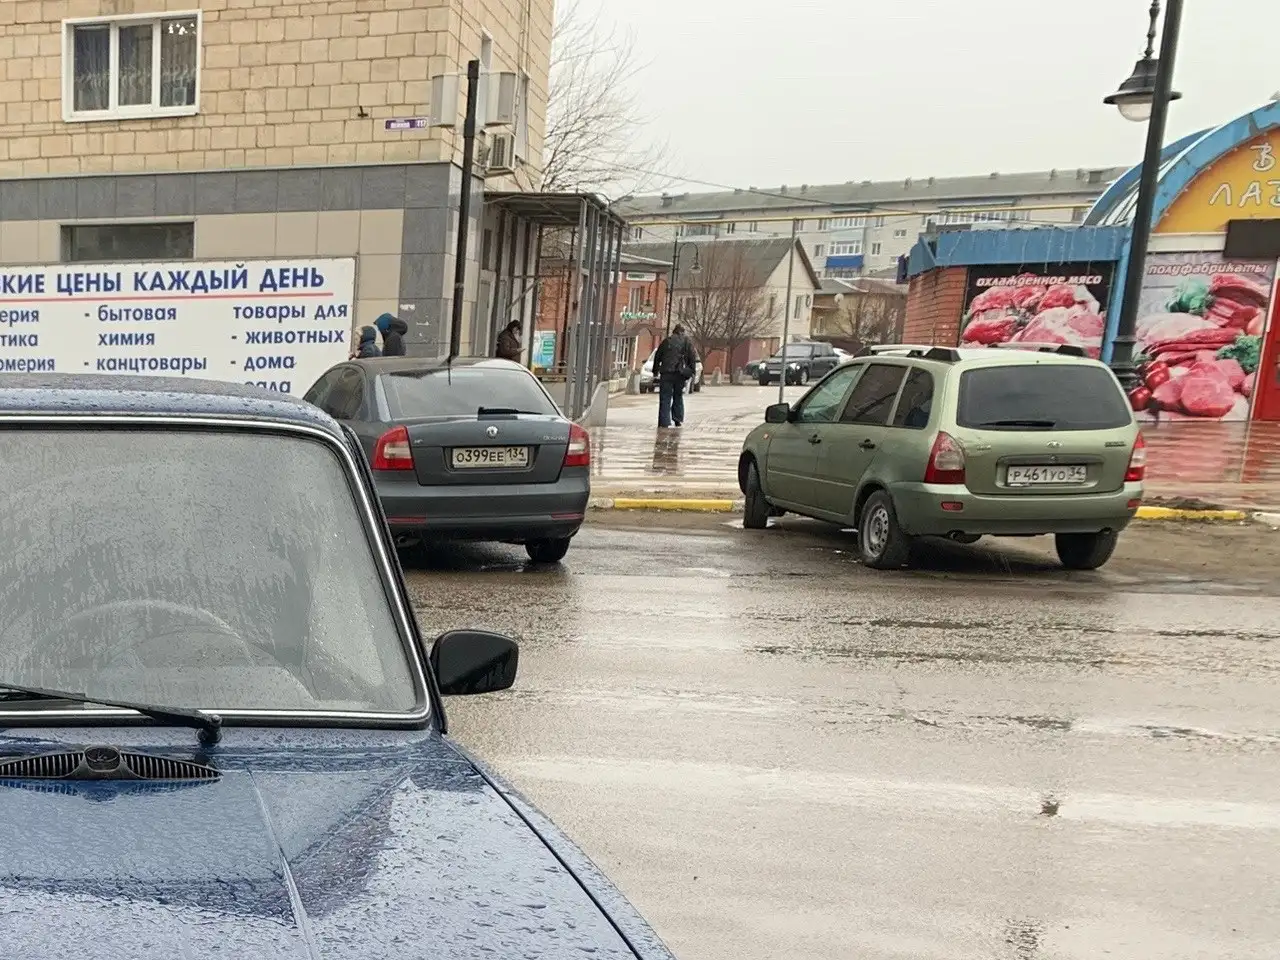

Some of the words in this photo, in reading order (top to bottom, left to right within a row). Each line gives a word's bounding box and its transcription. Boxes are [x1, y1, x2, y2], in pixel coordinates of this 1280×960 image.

[1250, 142, 1276, 171] В
[1148, 262, 1269, 276] полуфабрикаты
[56, 270, 122, 296] ЦЕНЫ
[133, 264, 248, 294] КАЖДЫЙ
[259, 267, 325, 292] ДЕНЬ
[1066, 275, 1103, 285] мясо
[97, 304, 177, 321] бытовая
[233, 305, 306, 323] товары
[314, 304, 348, 320] для
[97, 332, 155, 346] химия
[245, 329, 345, 344] животных
[96, 356, 208, 375] канцтовары
[243, 355, 296, 372] дома
[456, 449, 504, 463] О399ЕЕ
[507, 447, 525, 459] 134
[1013, 467, 1066, 482] Р461УО
